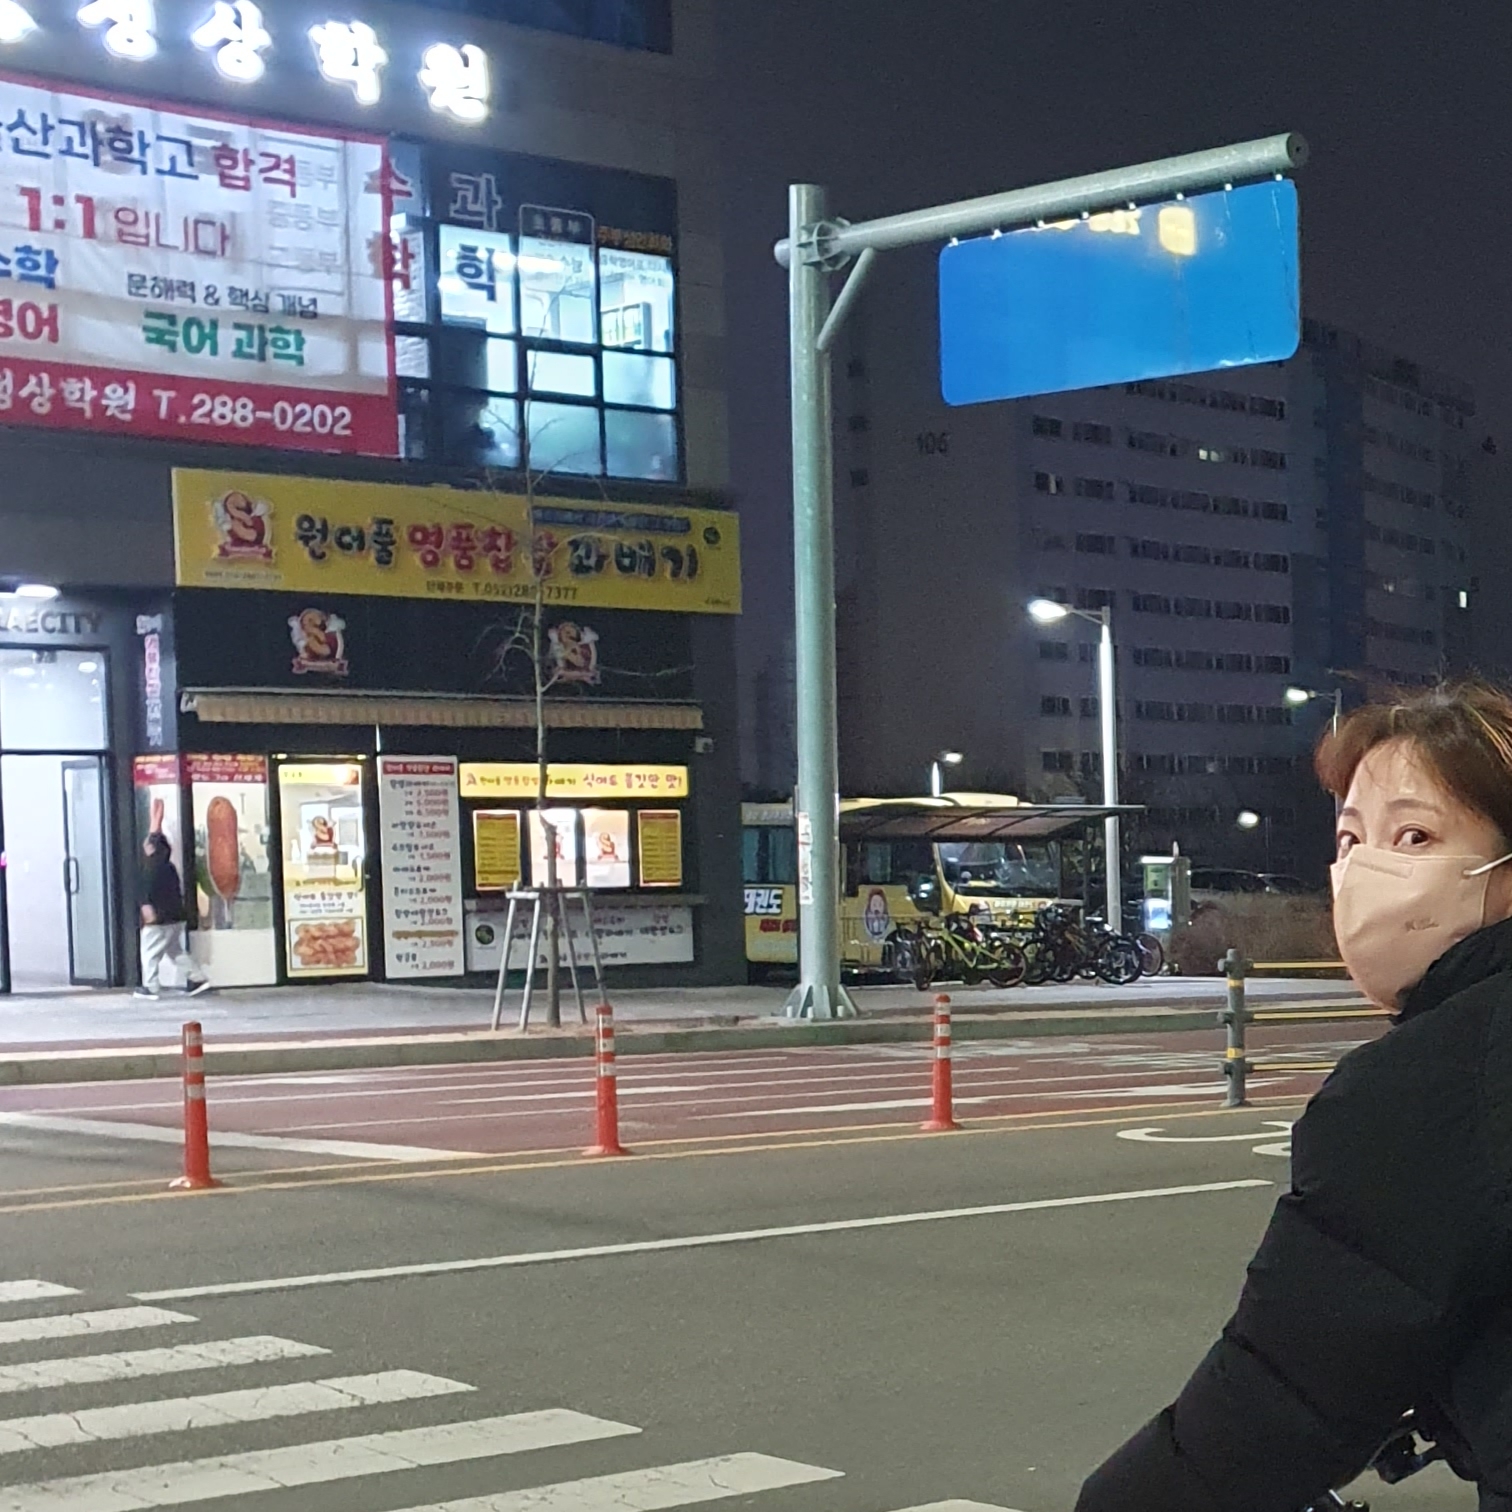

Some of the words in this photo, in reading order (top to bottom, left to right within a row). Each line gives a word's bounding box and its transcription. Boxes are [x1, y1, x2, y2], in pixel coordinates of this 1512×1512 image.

[0, 108, 199, 181] 산과학고
[211, 141, 296, 198] 합격
[19, 186, 96, 239] 1:1
[114, 206, 230, 257] 입니다
[127, 272, 196, 303] 문해력
[203, 283, 220, 307] &
[227, 285, 270, 315] 핵심
[142, 308, 219, 357] 국어
[231, 321, 306, 367] 과학
[152, 388, 353, 437] T.288-0202
[0, 611, 100, 635] AECITY
